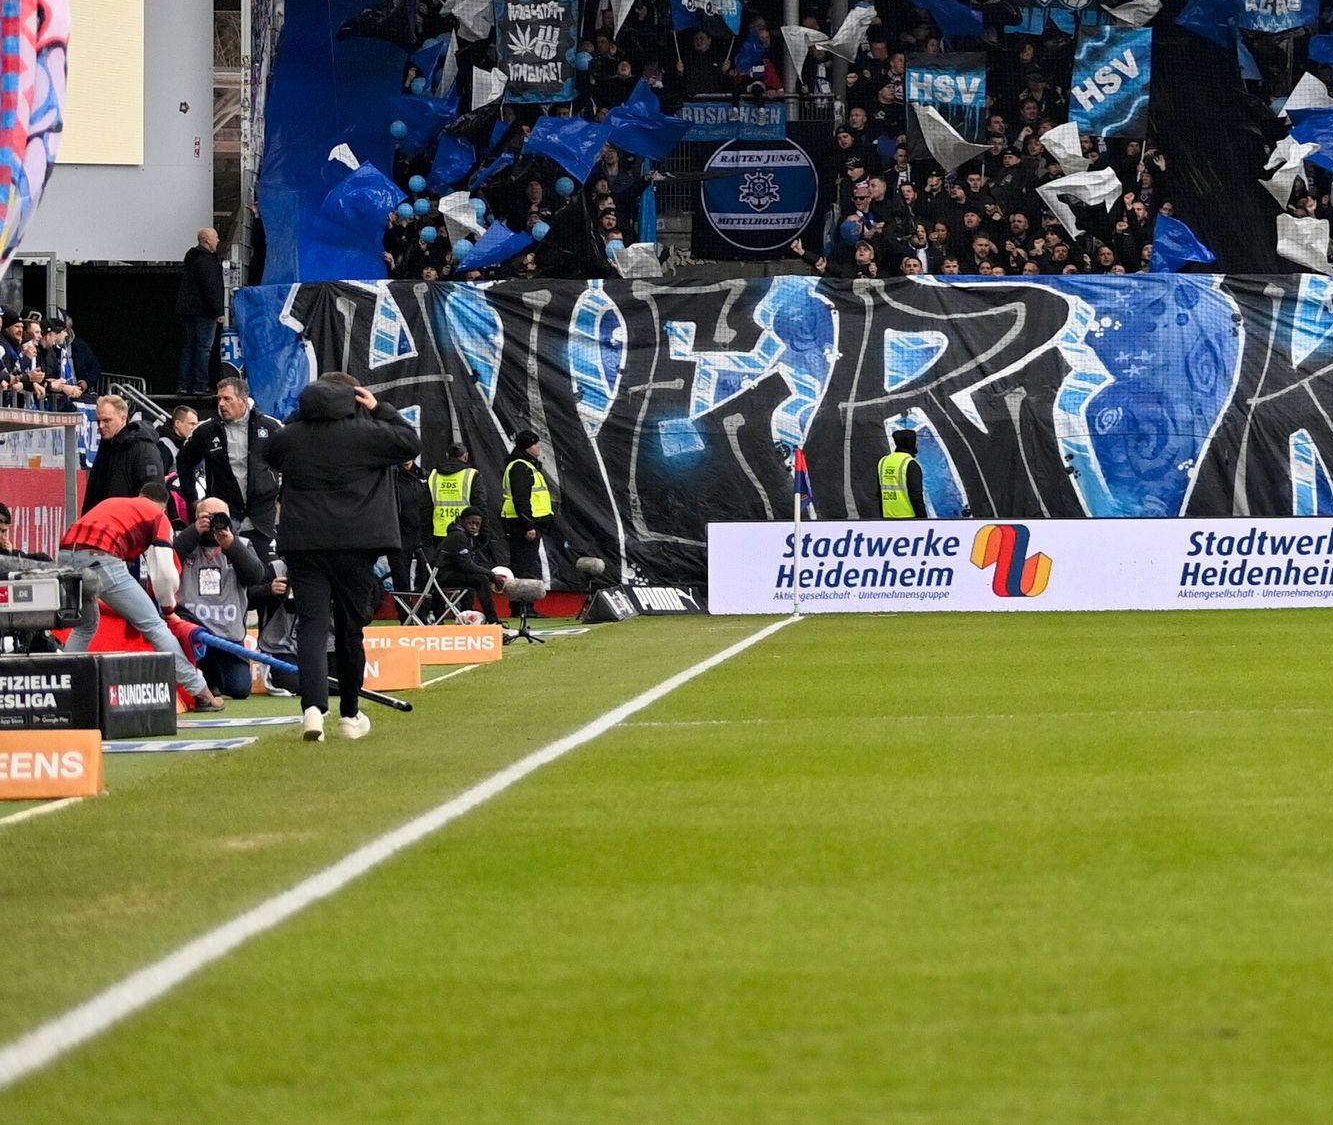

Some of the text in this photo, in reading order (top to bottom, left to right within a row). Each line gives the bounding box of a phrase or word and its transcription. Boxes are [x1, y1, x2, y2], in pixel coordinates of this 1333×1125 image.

[909, 72, 981, 104] HSV
[1069, 48, 1140, 112] HSV
[720, 154, 800, 164] RAUTEN JUNGS
[717, 216, 804, 226] MITTELHOLSTEIN
[440, 508, 460, 518] 2156
[782, 529, 960, 558] Stadtwerke
[775, 561, 954, 588] Heidenheim
[773, 590, 950, 601] Aktiegesellschaft Unternehmensgruppe
[1177, 588, 1255, 600] Aktiengesellschaft
[397, 635, 495, 651] SCREENS
[119, 682, 171, 706] BUNDESLIGA
